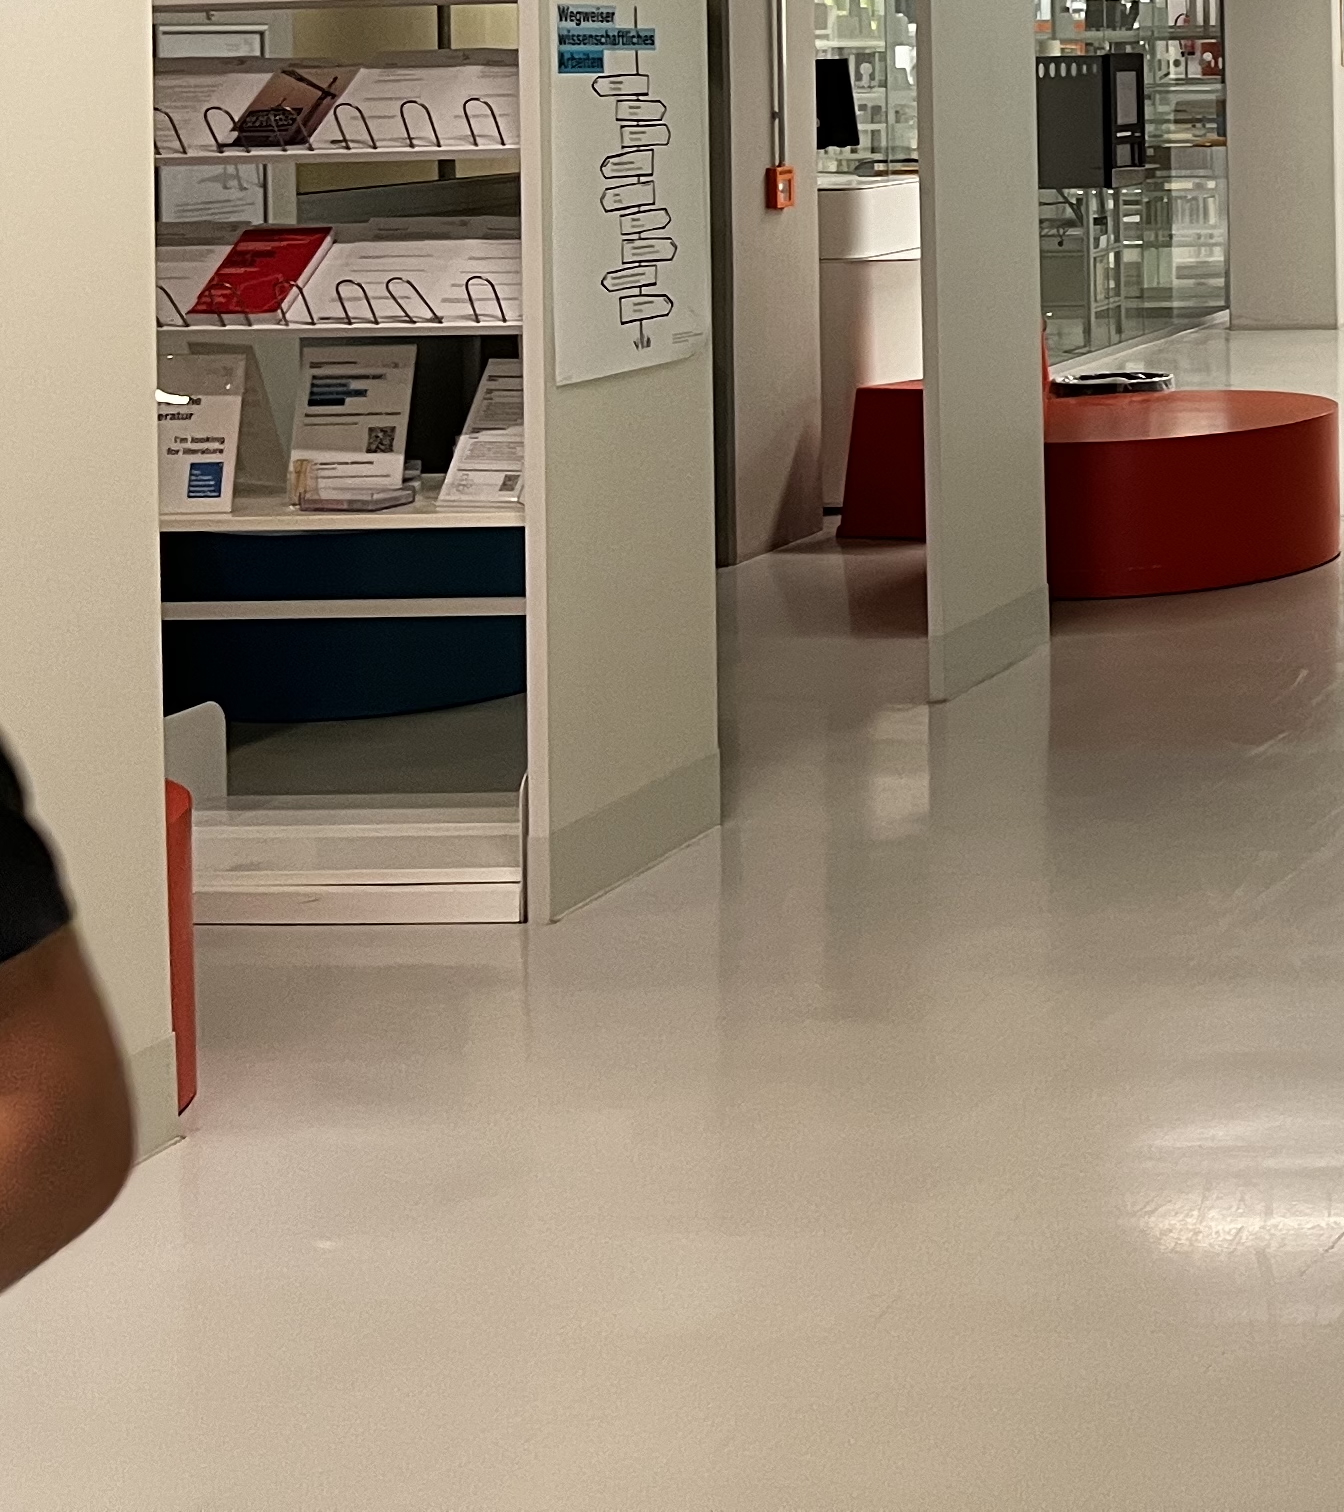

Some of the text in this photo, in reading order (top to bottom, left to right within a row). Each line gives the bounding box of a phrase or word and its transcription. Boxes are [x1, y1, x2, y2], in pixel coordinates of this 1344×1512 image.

[558, 5, 615, 26] Wegweiser
[558, 29, 655, 46] wissenschaftliches
[559, 51, 603, 69] Arbeiten
[174, 435, 226, 444] I'm looking
[167, 447, 224, 455] for literature
